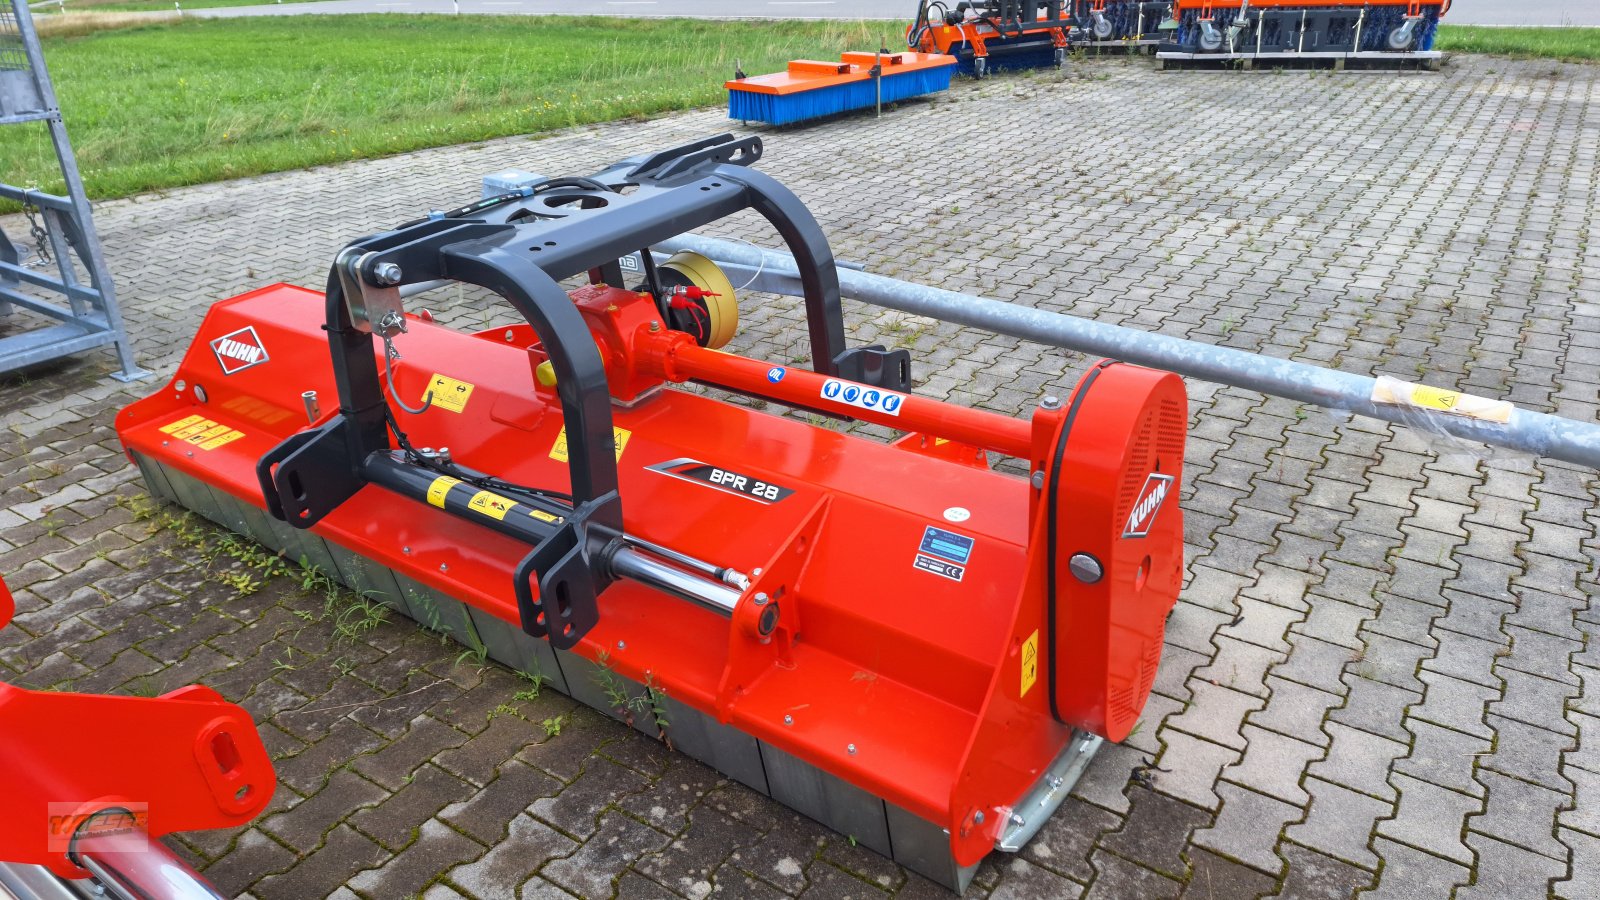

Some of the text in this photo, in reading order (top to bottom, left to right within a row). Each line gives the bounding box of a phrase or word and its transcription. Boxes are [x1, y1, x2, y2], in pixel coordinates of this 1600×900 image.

[217, 338, 261, 363] KUHN
[769, 368, 781, 381] OIL
[709, 468, 779, 500] BPR 28
[1130, 479, 1166, 533] KUHN
